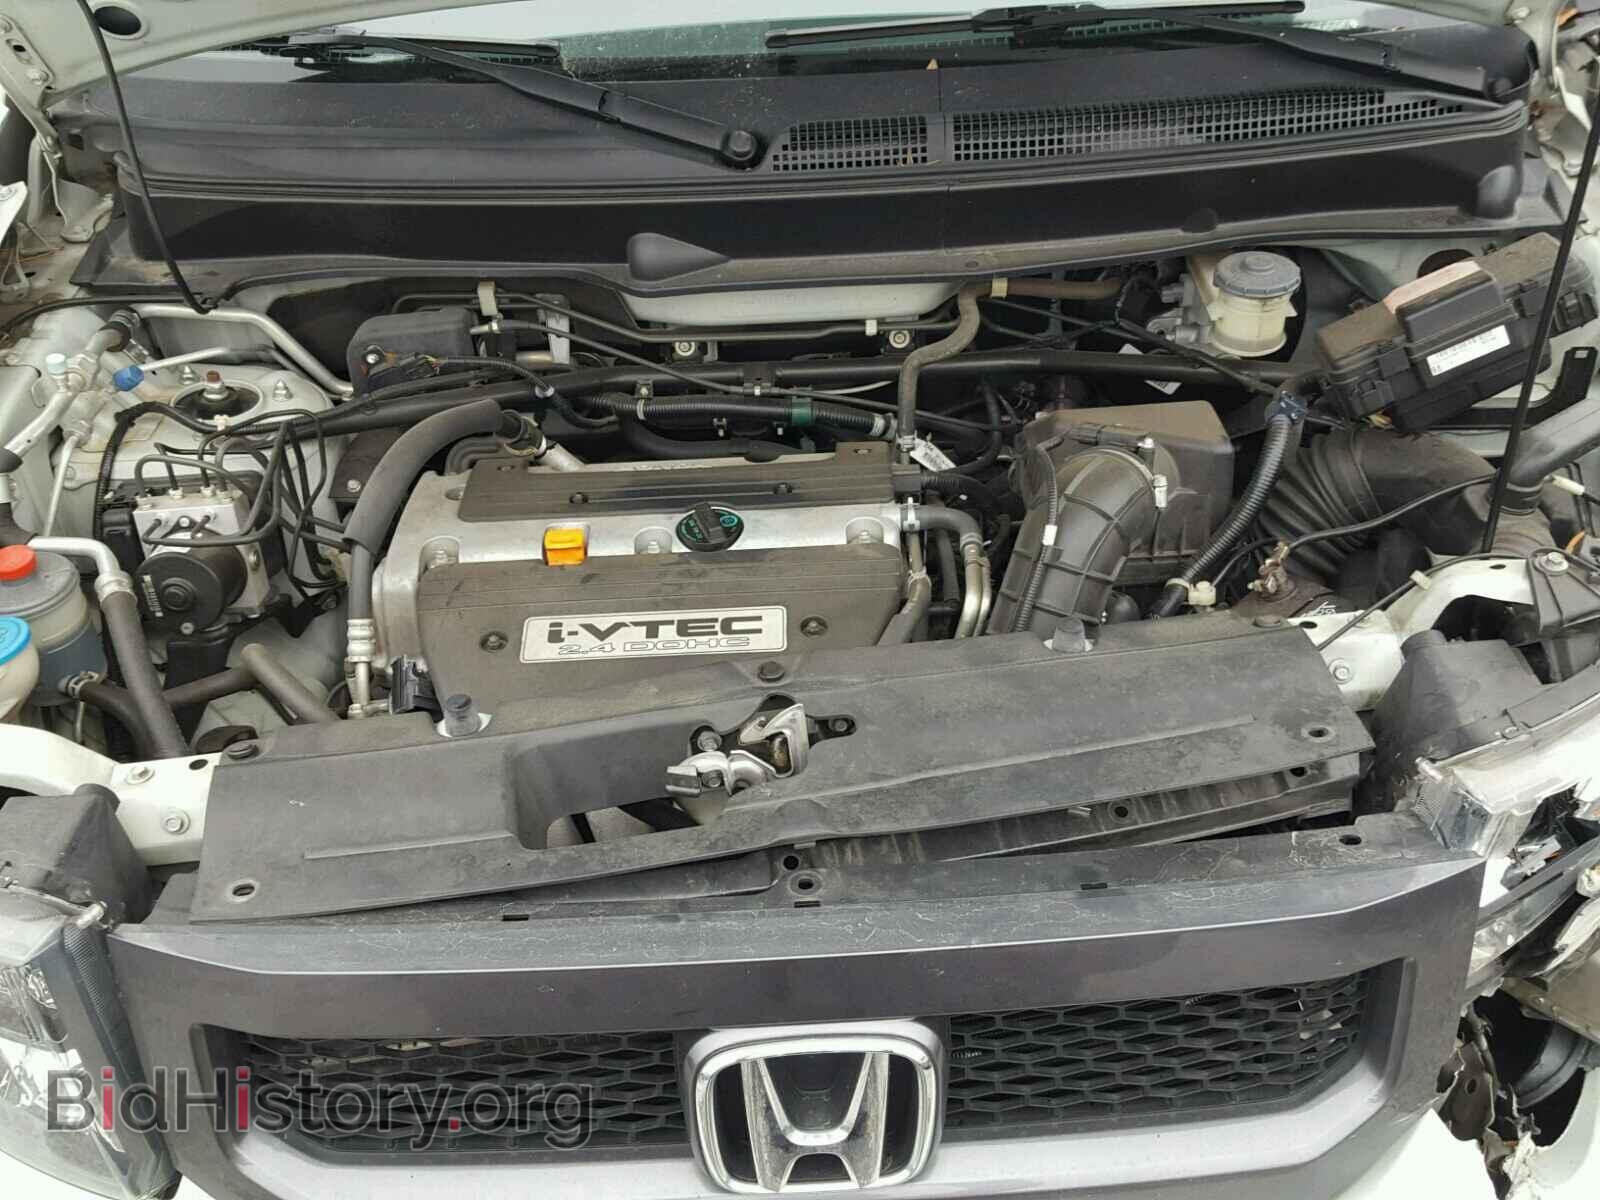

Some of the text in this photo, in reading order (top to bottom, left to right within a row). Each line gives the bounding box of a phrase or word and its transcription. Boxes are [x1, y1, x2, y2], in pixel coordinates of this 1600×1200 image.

[547, 615, 763, 643] i-VTEC
[558, 637, 750, 656] 2.4 DOHC
